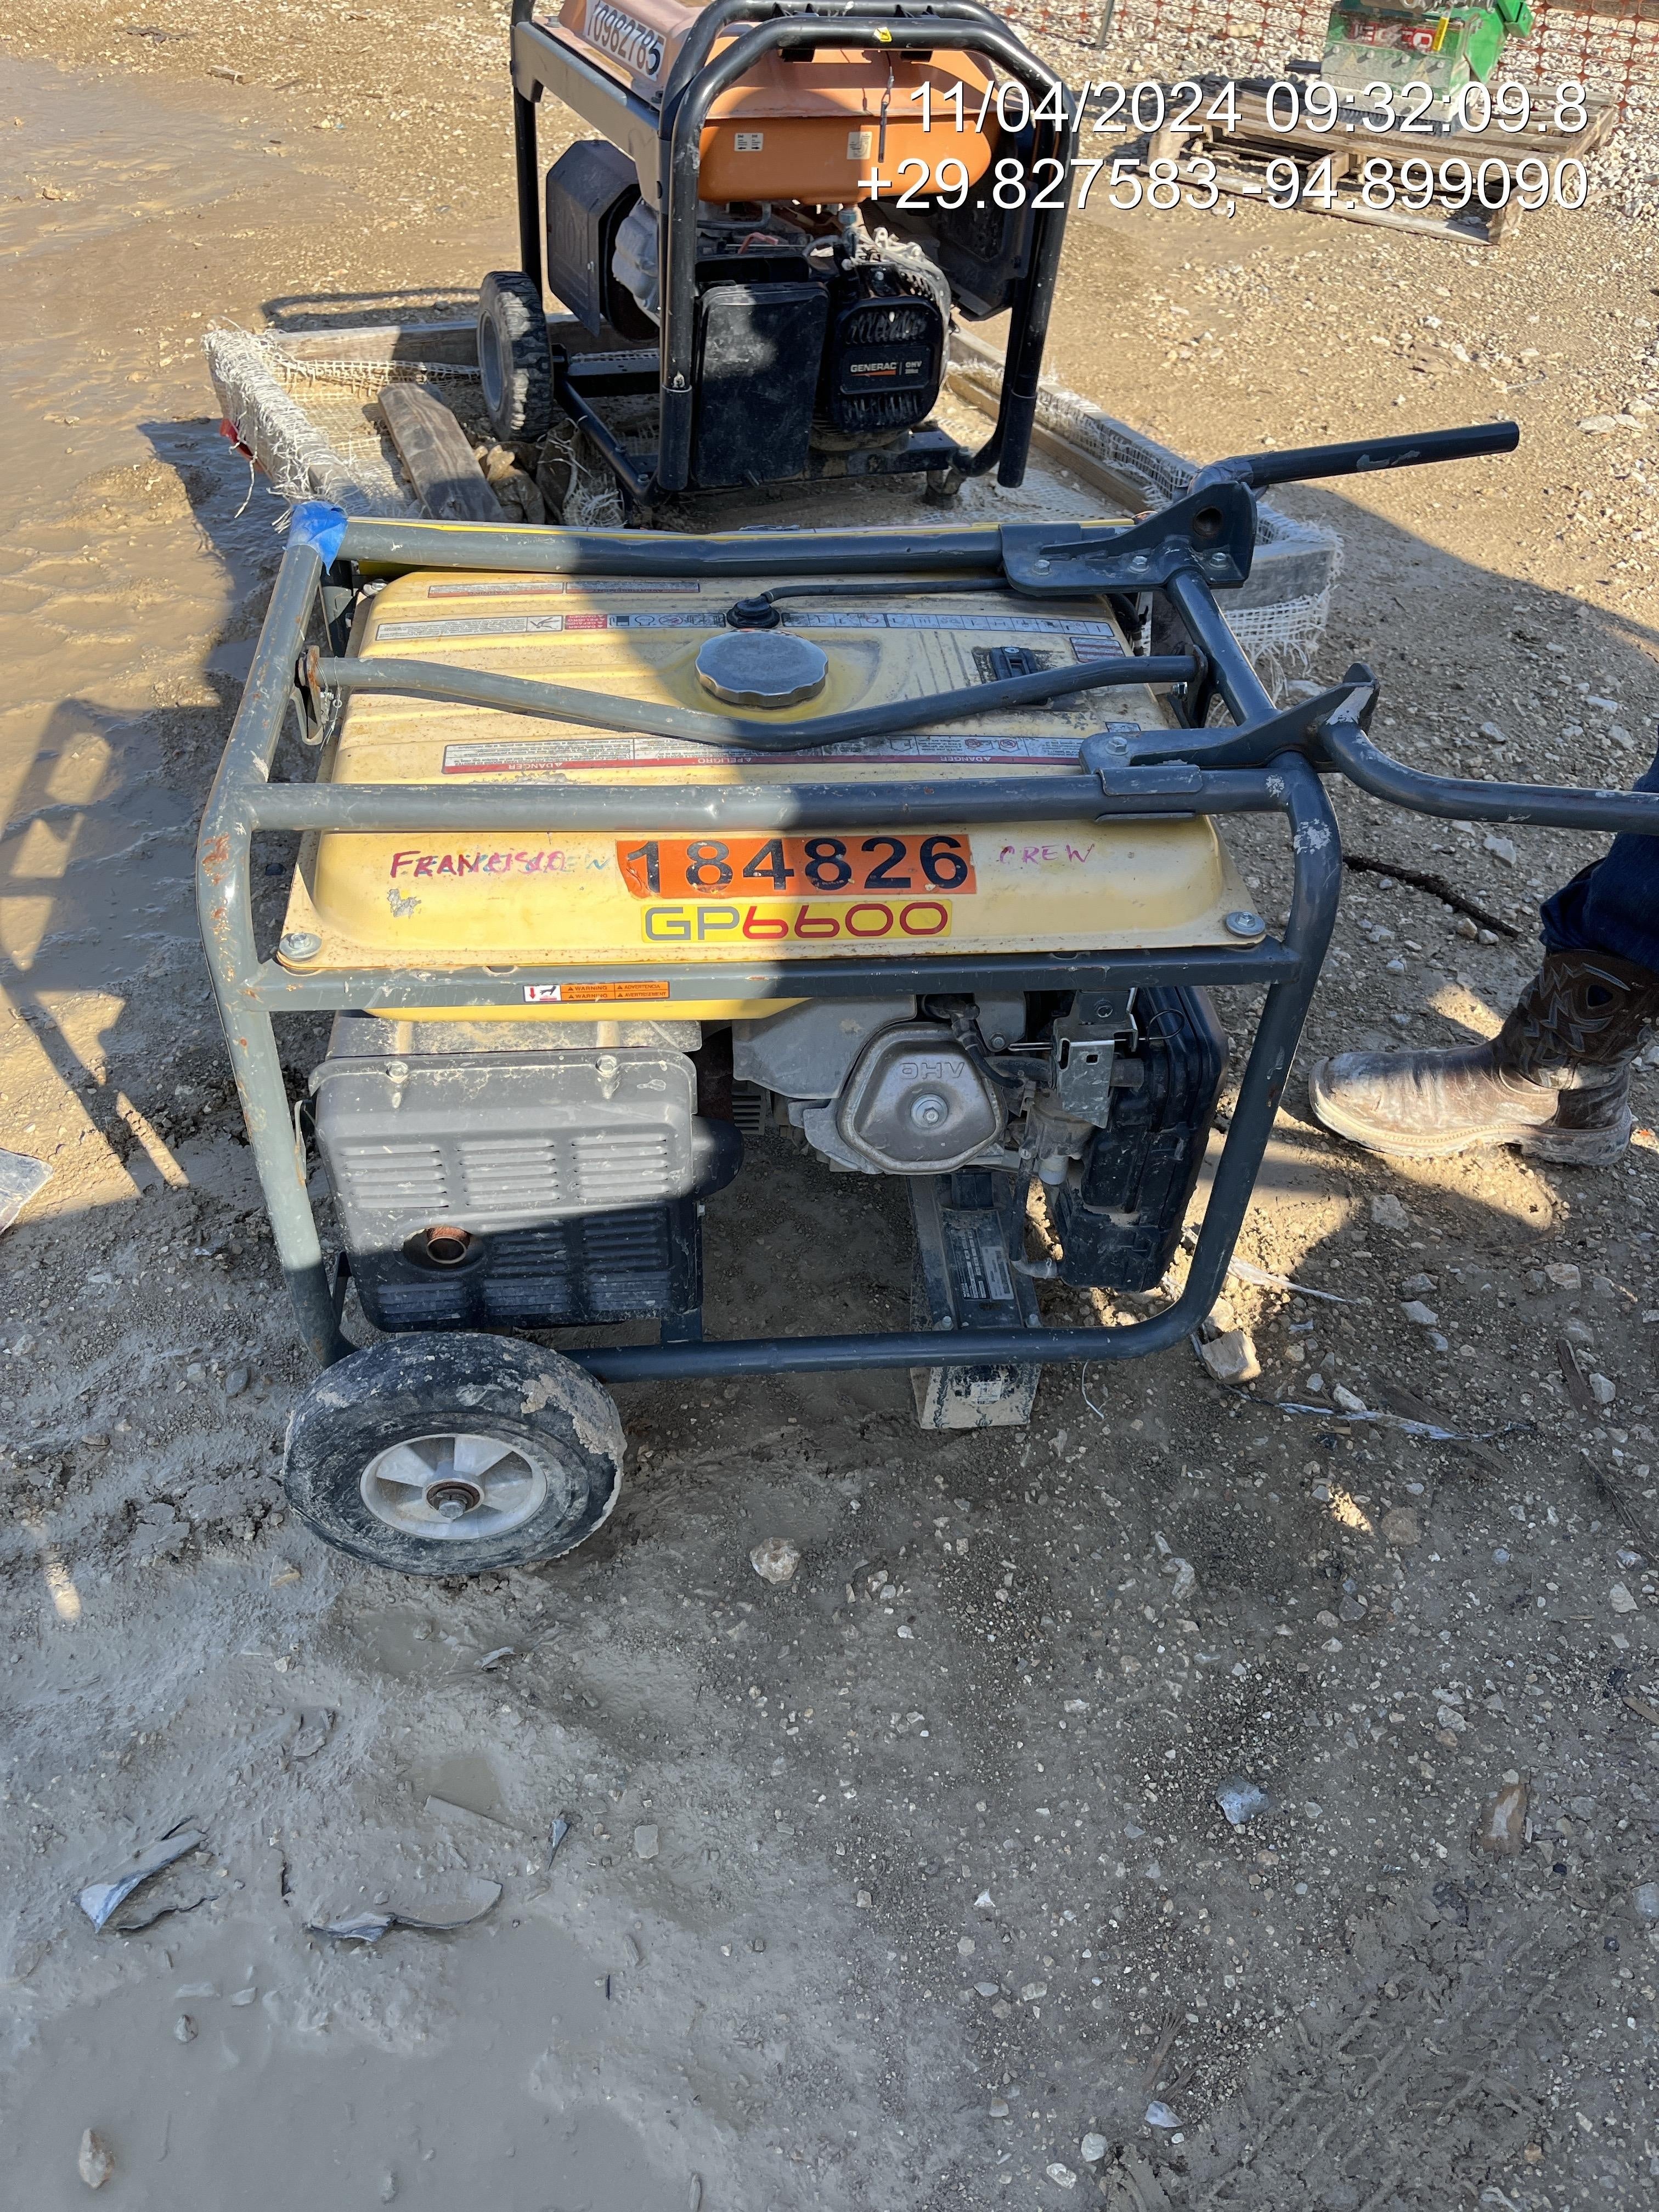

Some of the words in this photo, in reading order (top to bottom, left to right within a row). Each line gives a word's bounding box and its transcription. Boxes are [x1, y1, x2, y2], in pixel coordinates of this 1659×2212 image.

[588, 0, 664, 75] 10982785
[850, 362, 896, 372] GENERAC
[628, 836, 968, 893] 184826
[1000, 843, 1095, 865] CREW
[645, 901, 948, 940] GP6600
[899, 1062, 965, 1080] OHV
